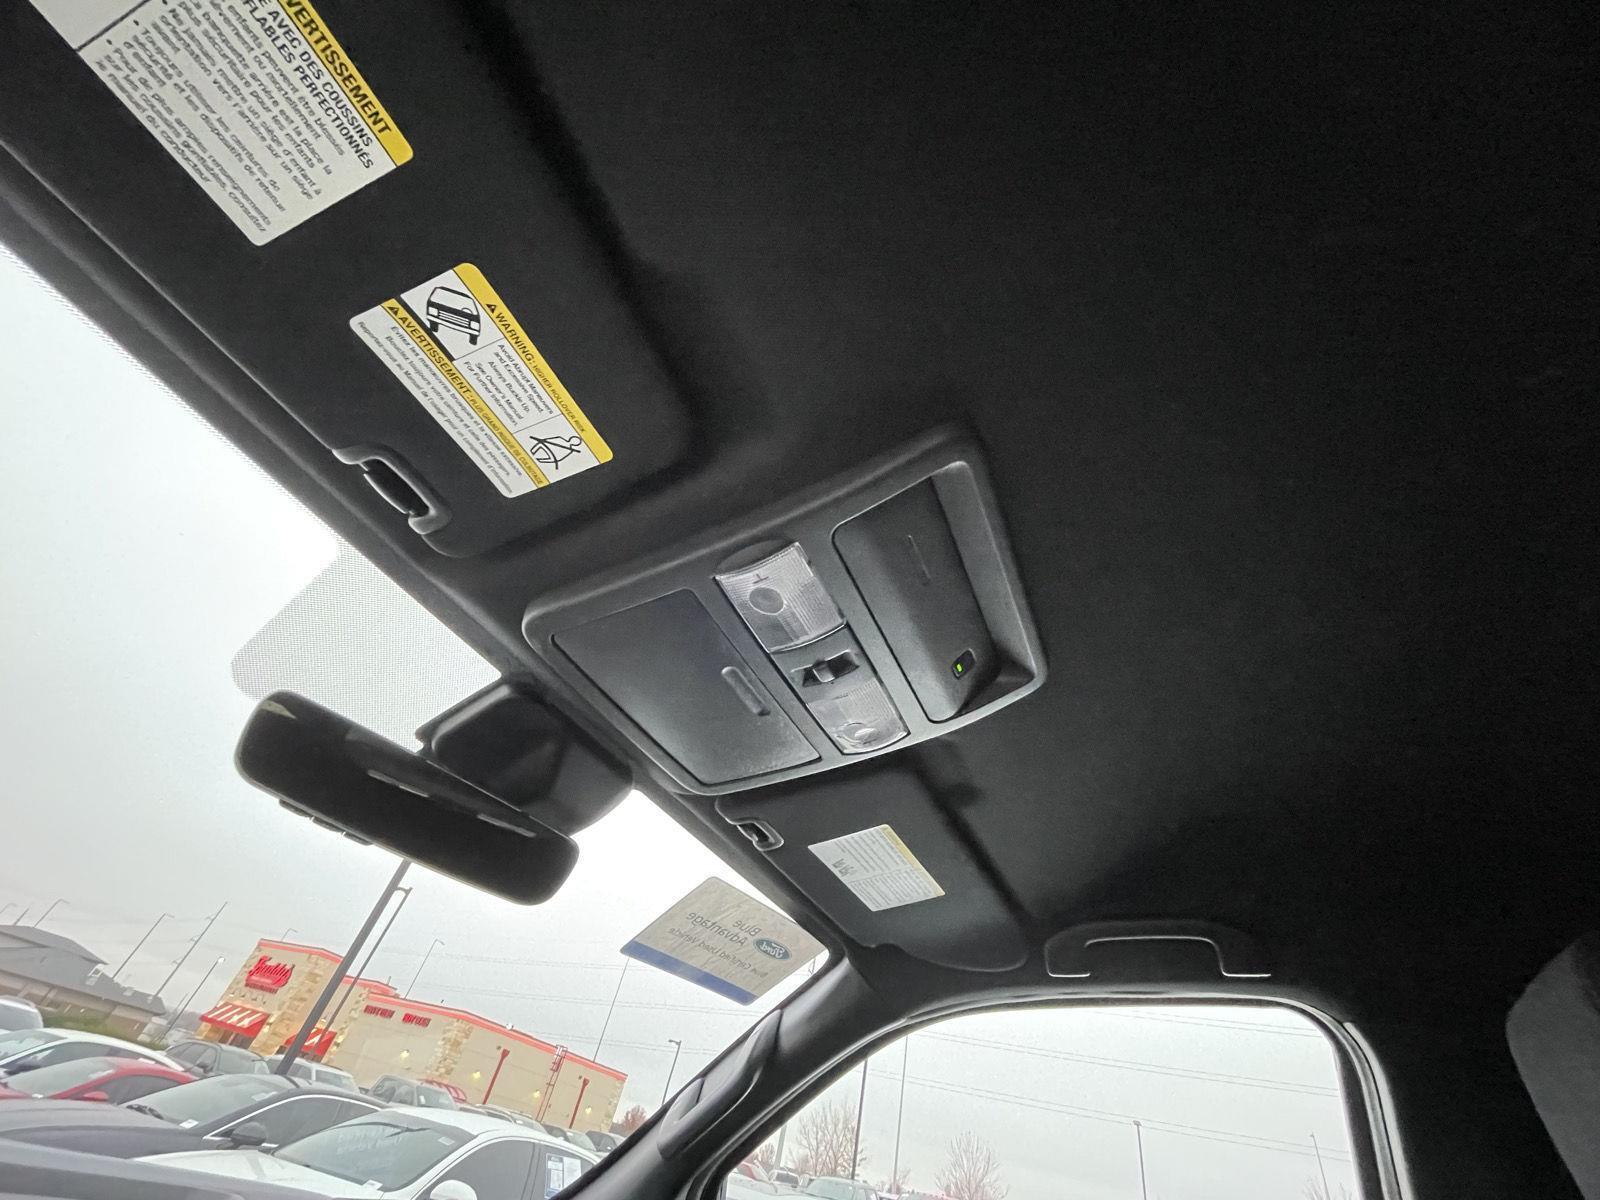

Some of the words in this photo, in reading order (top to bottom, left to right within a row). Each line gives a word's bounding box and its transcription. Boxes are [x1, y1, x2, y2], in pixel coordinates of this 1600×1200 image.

[241, 0, 296, 64] FLABLES
[291, 64, 376, 169] PERFECTIONNÉS
[267, 7, 302, 49] AVEC
[298, 50, 325, 80] DES
[320, 80, 374, 147] COUSSINS
[283, 0, 393, 137] VERTISSEMENT
[493, 312, 537, 364] WARNING:
[532, 364, 553, 388] HIGHER
[550, 388, 576, 419] ROLLOVER
[497, 343, 515, 362] Avoid
[511, 362, 531, 383] Abrupt
[527, 382, 555, 414] Maneuvers
